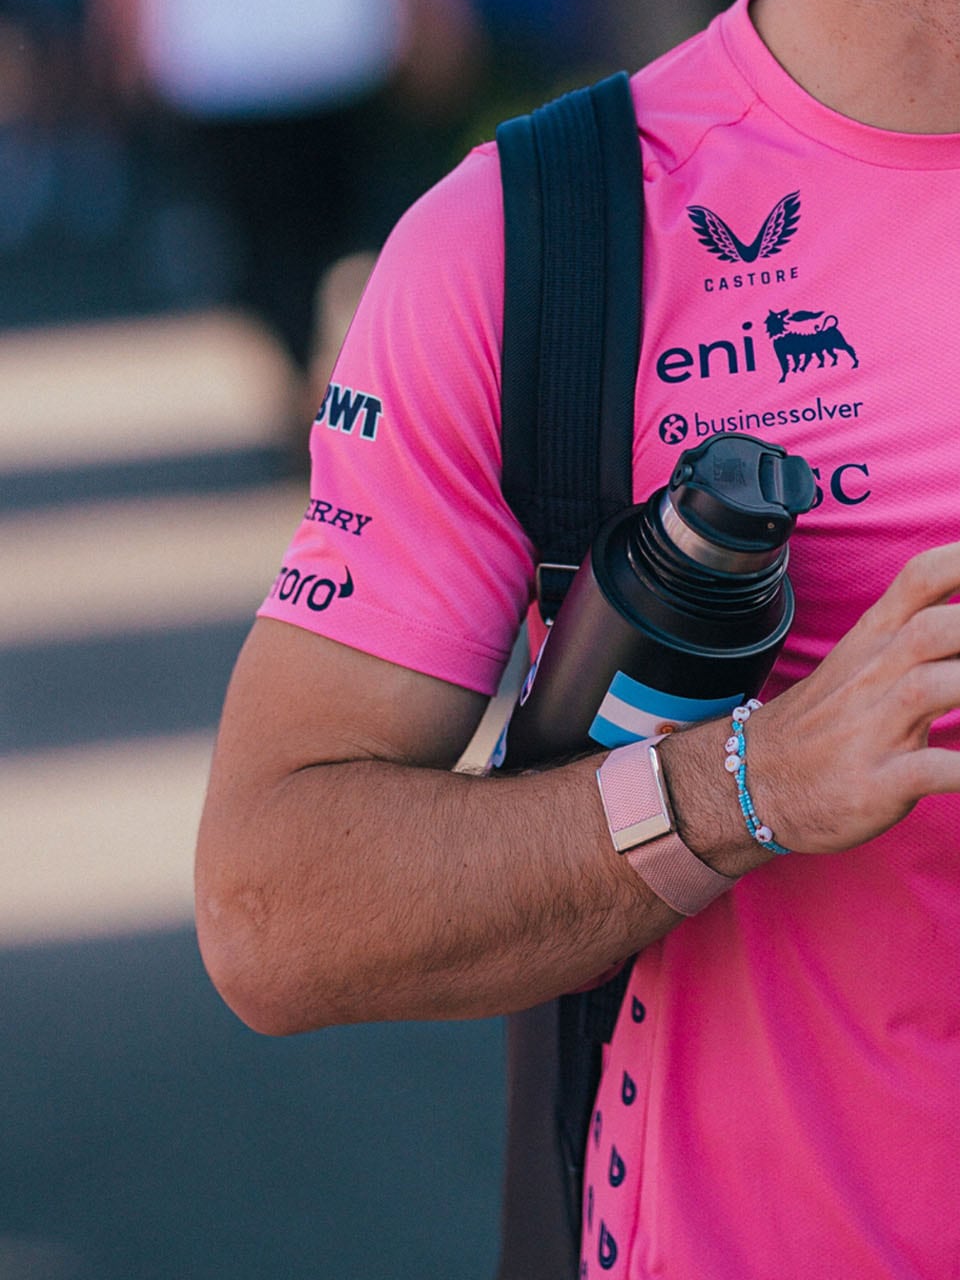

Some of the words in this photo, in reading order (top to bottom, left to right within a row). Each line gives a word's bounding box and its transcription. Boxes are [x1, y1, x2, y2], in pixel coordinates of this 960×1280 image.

[704, 267, 798, 292] CASTORE
[656, 321, 756, 384] eni
[695, 397, 864, 436] businessolver
